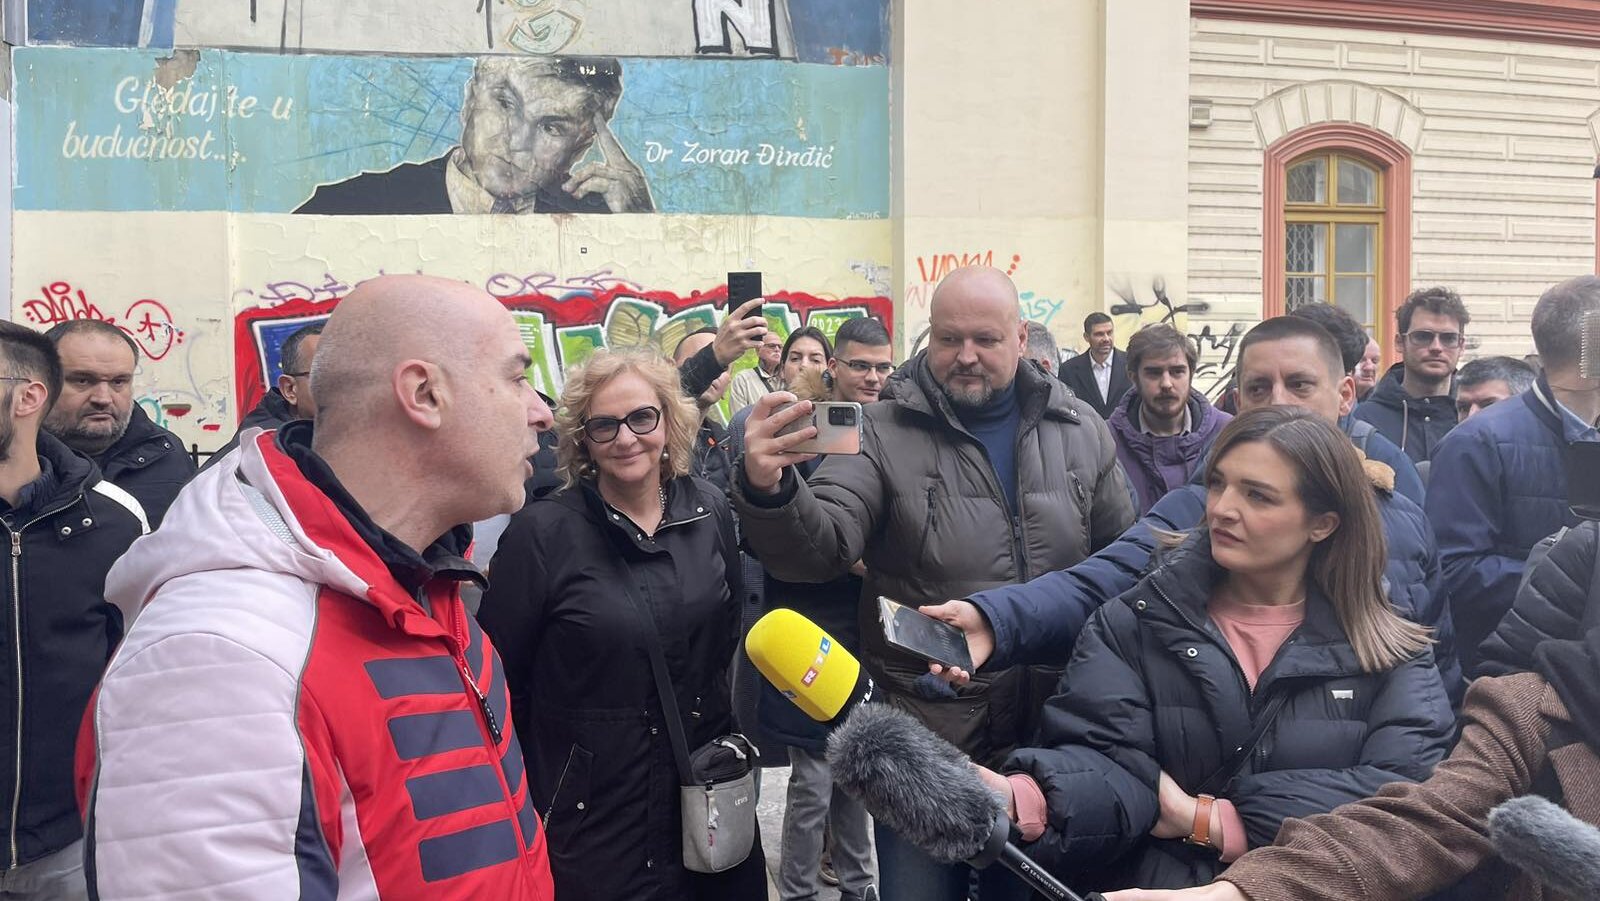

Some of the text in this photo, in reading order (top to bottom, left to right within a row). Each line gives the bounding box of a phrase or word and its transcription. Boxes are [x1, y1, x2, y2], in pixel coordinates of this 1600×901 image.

[271, 95, 294, 121] u
[644, 140, 836, 169] Dr Zoran Đinđić
